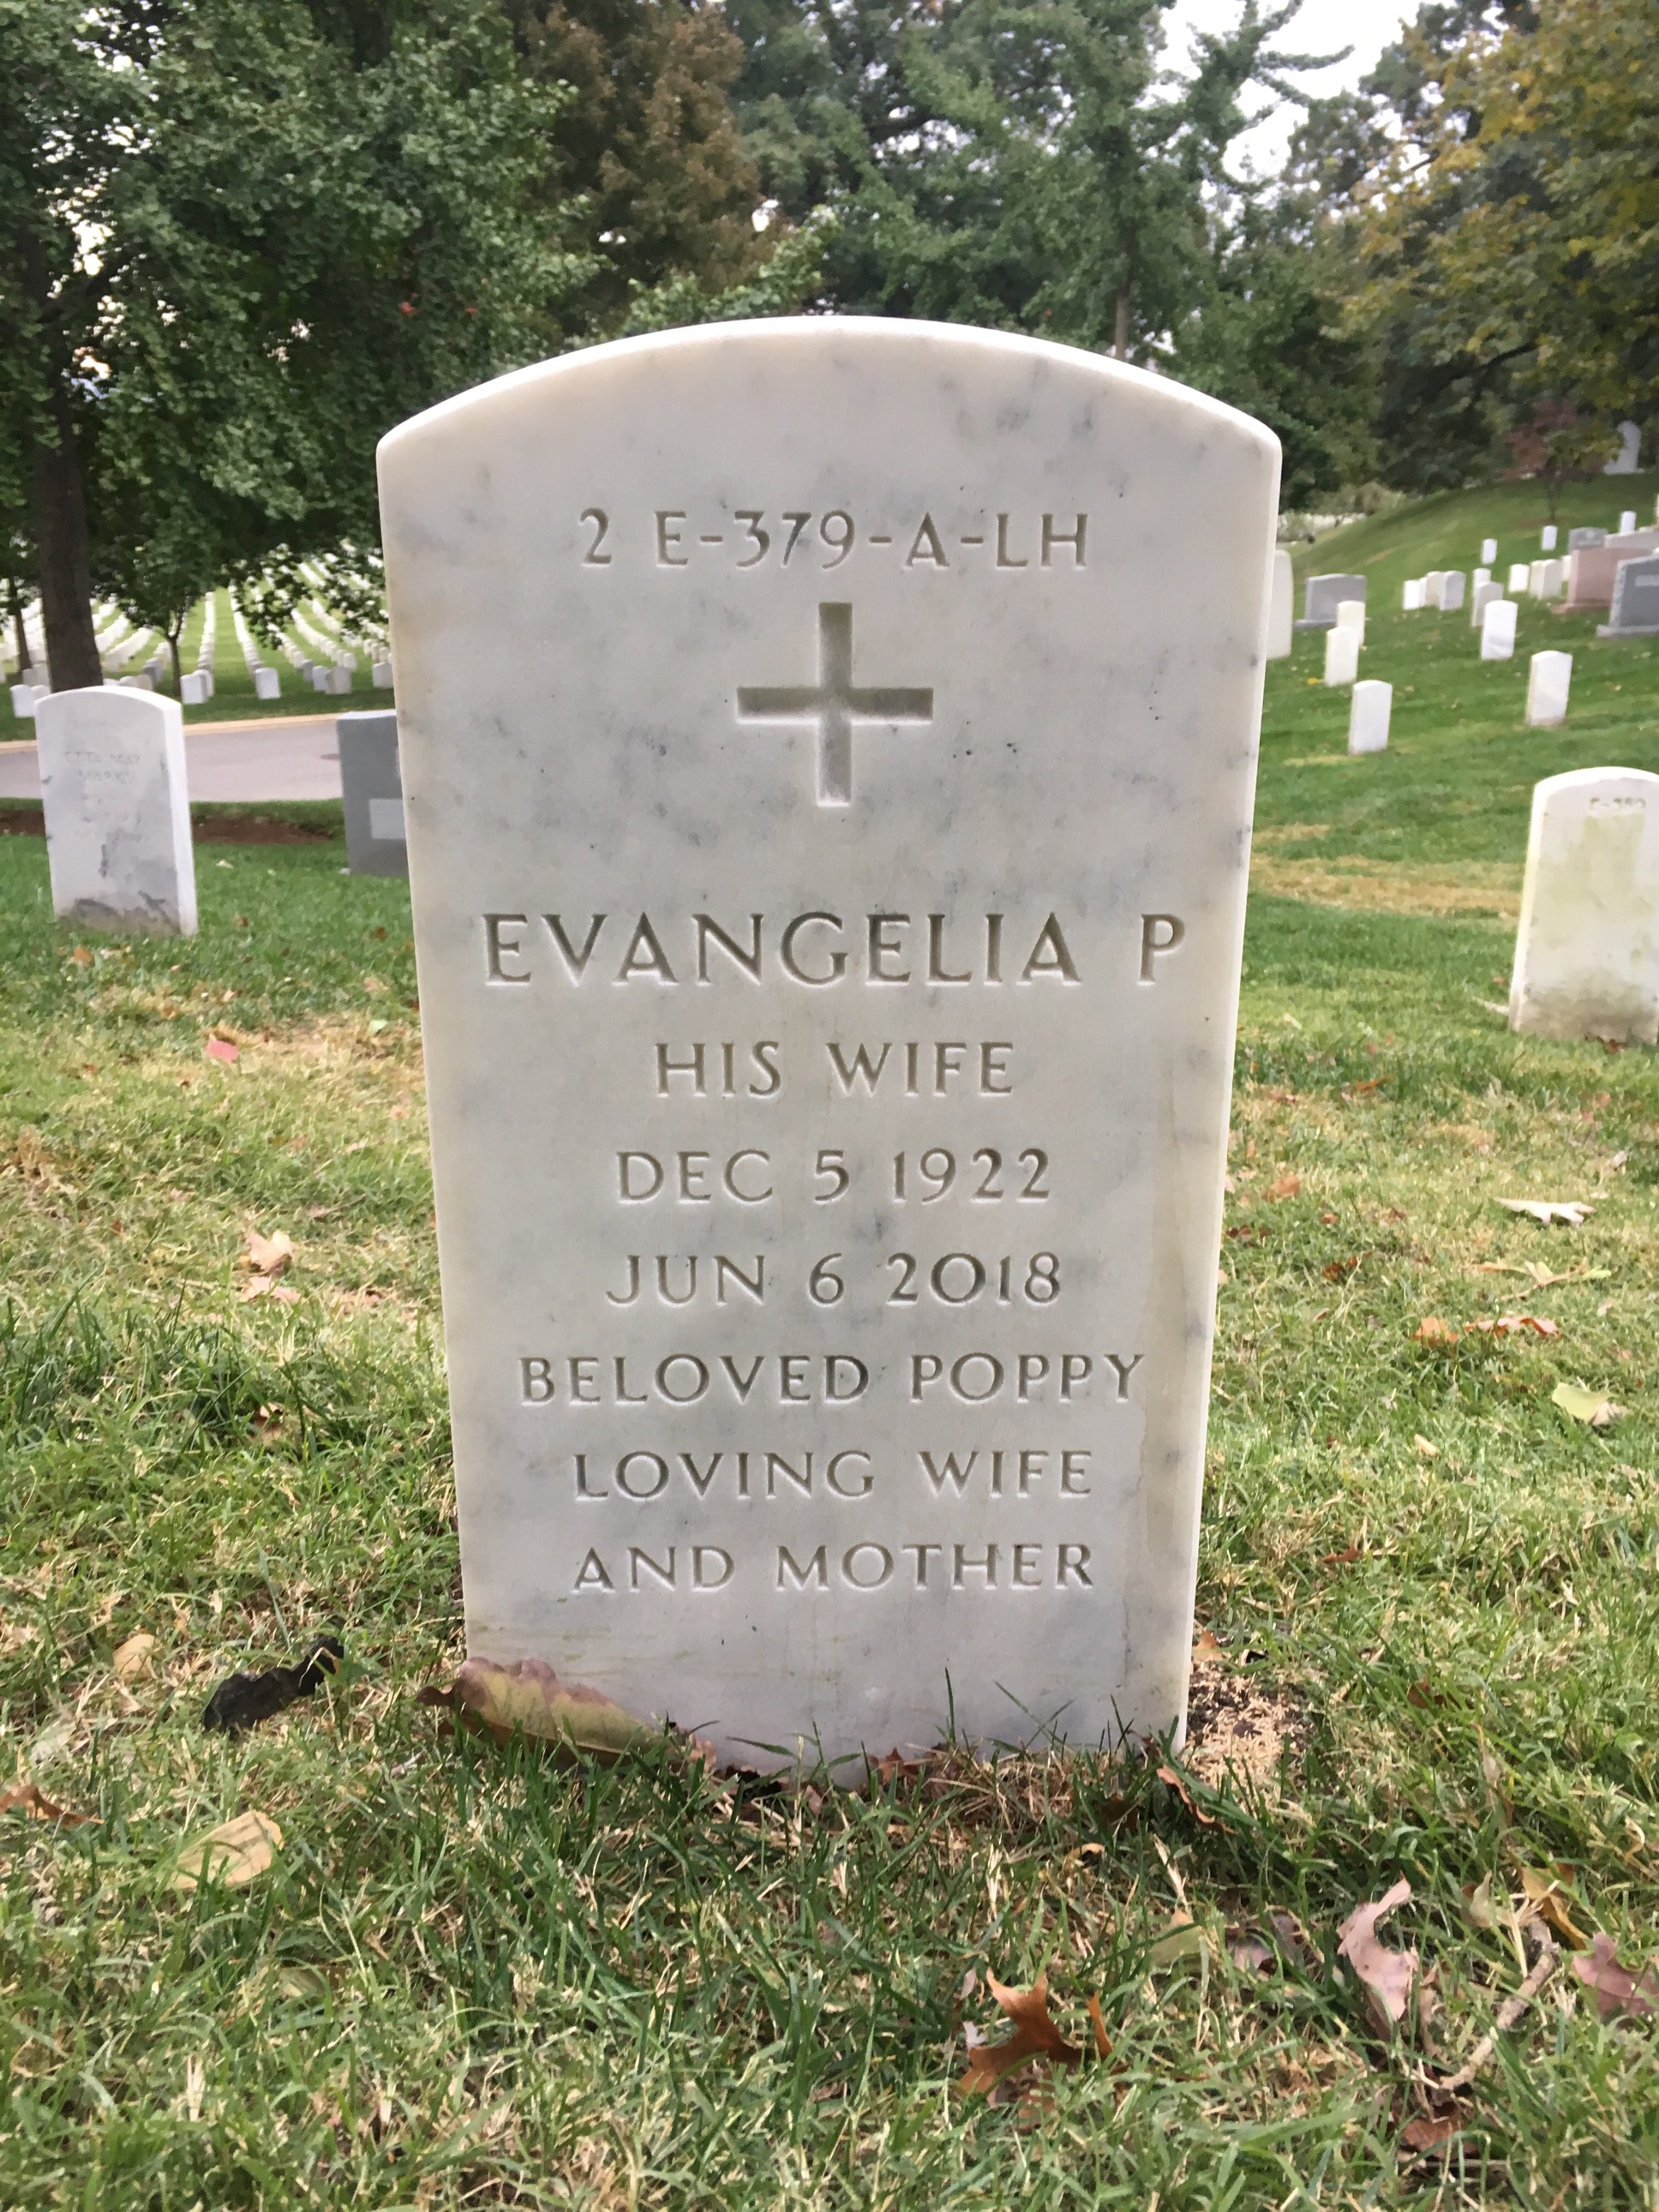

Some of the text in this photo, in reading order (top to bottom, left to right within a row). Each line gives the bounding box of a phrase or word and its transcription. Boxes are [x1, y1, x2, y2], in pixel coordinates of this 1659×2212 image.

[580, 507, 1089, 569] 2 E-379-A-LH
[482, 912, 1186, 986] EVANGELIA P
[654, 1040, 1015, 1099] HIS WIFE
[614, 1147, 1052, 1204] DEC 5 1922
[605, 1251, 1063, 1307] JUN 6 2018
[518, 1352, 1146, 1406] BELOVED POPPY
[573, 1448, 1094, 1502] LOVING WIFE
[571, 1543, 1095, 1593] AND MOTHER
